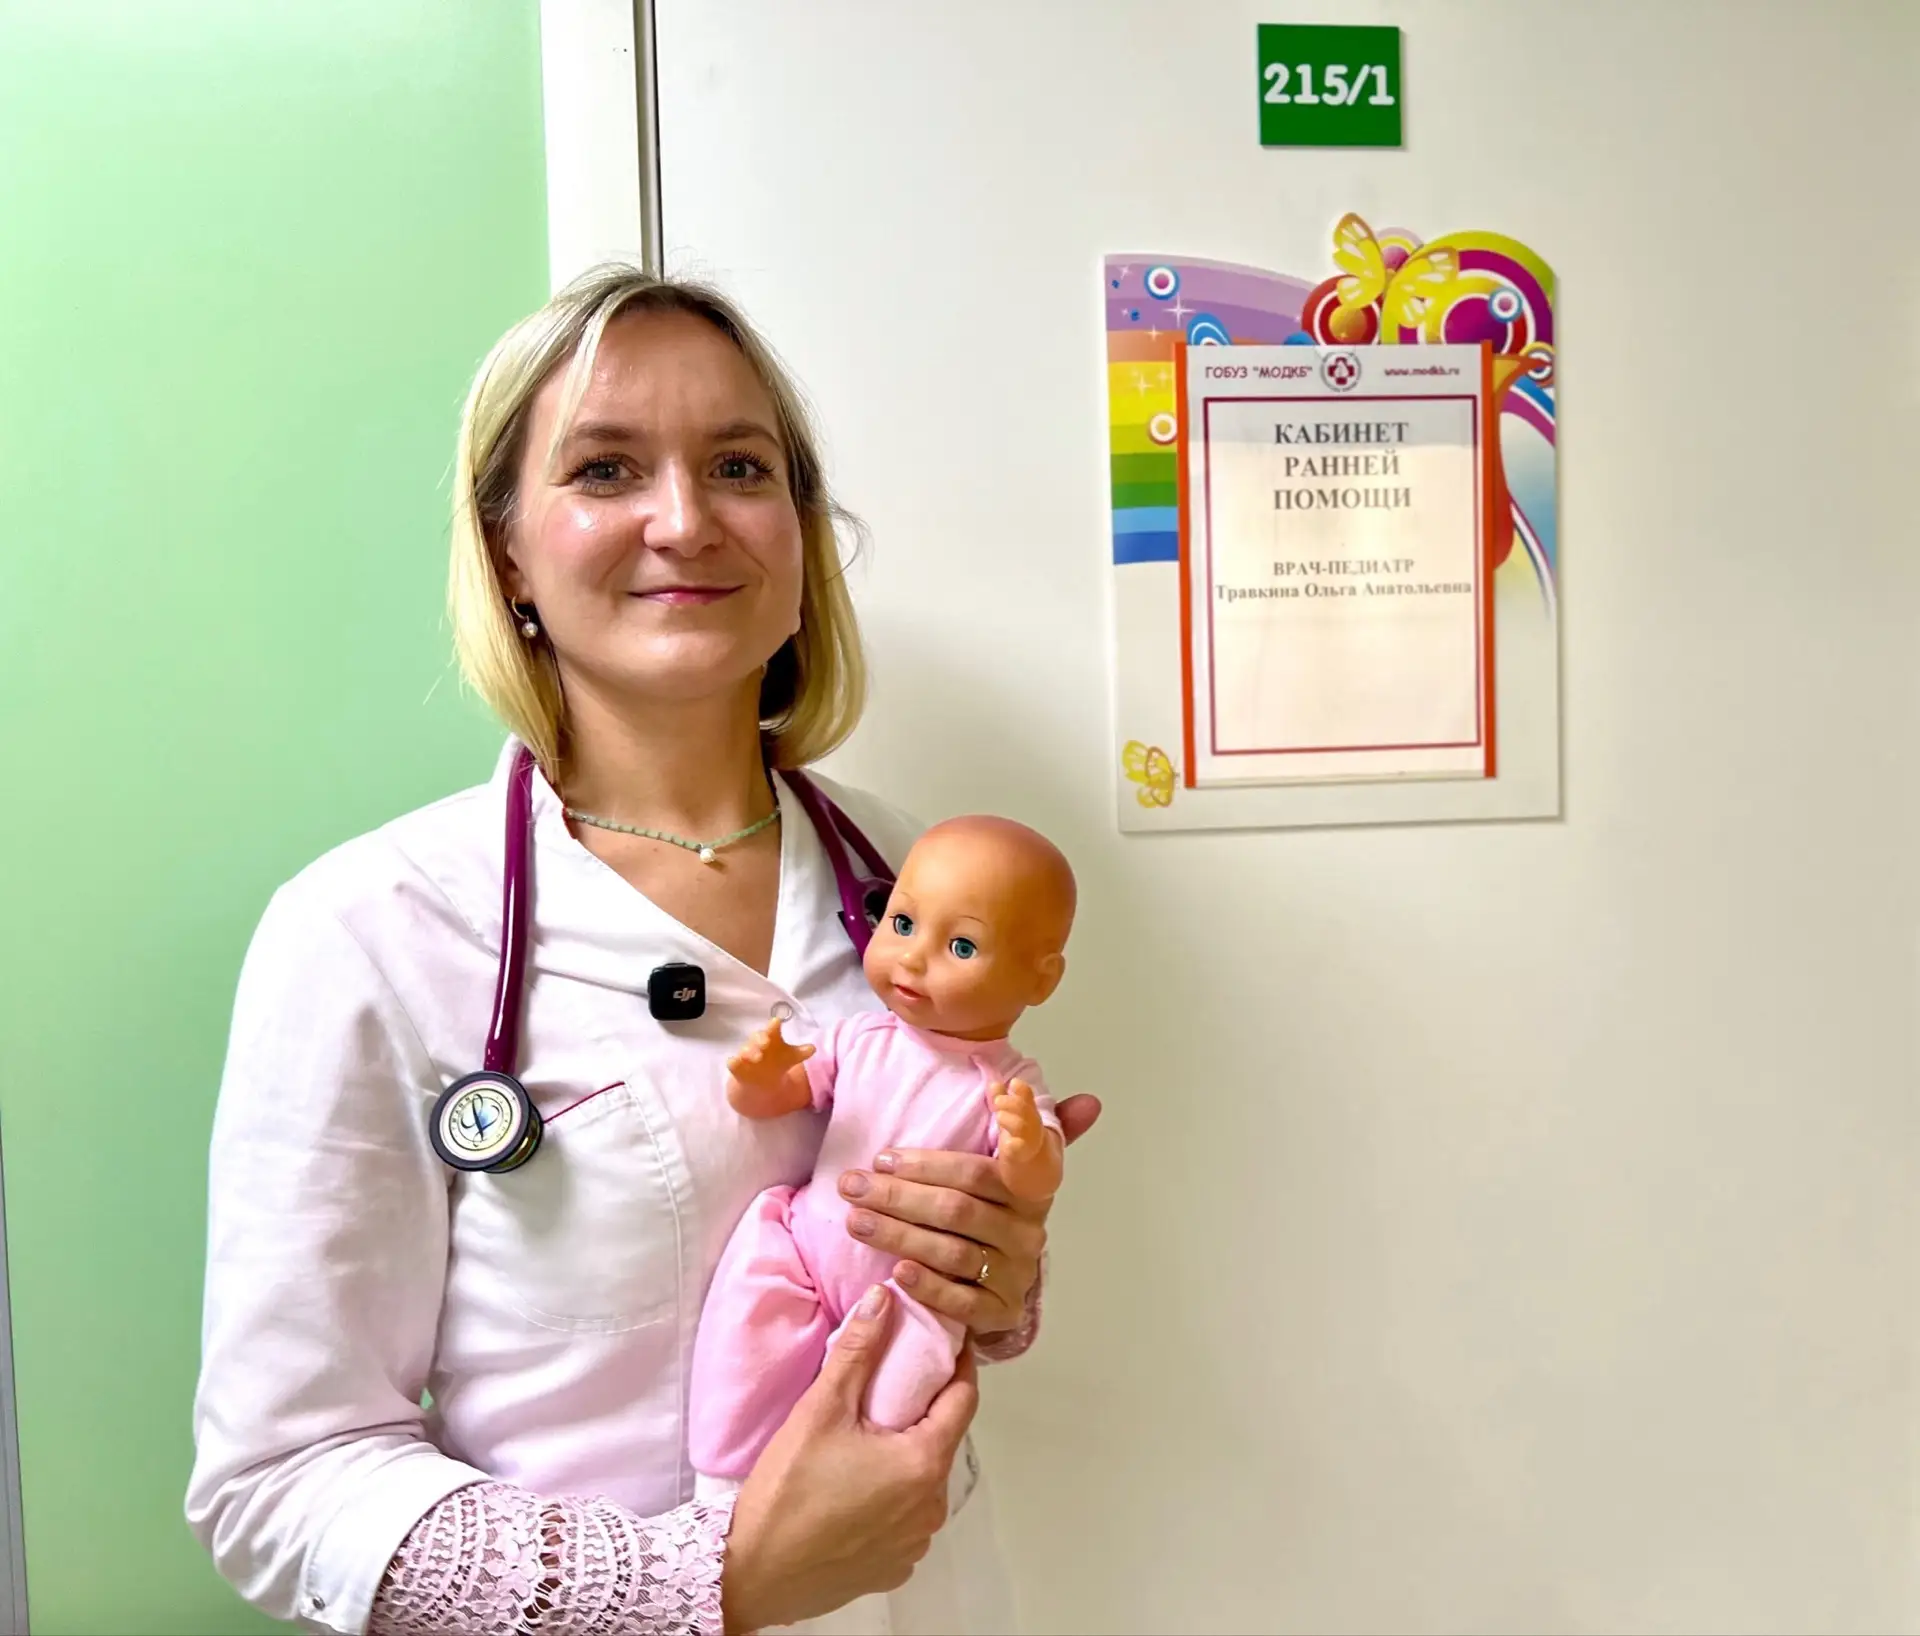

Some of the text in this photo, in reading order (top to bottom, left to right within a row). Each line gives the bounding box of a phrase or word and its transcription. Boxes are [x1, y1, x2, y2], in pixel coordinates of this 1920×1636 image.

[1264, 62, 1395, 106] 215/1
[1205, 366, 1313, 380] ГОБУЗ "МОДКБ"
[1274, 422, 1409, 445] КАБИНЕТ
[1284, 449, 1400, 478] РАННЕЙ
[1273, 487, 1412, 511] ПОМОЩИ
[1273, 559, 1415, 576] ВРАЧ-ПЕДИАТР
[1215, 581, 1472, 602] Травкина Ольга Анатольевна
